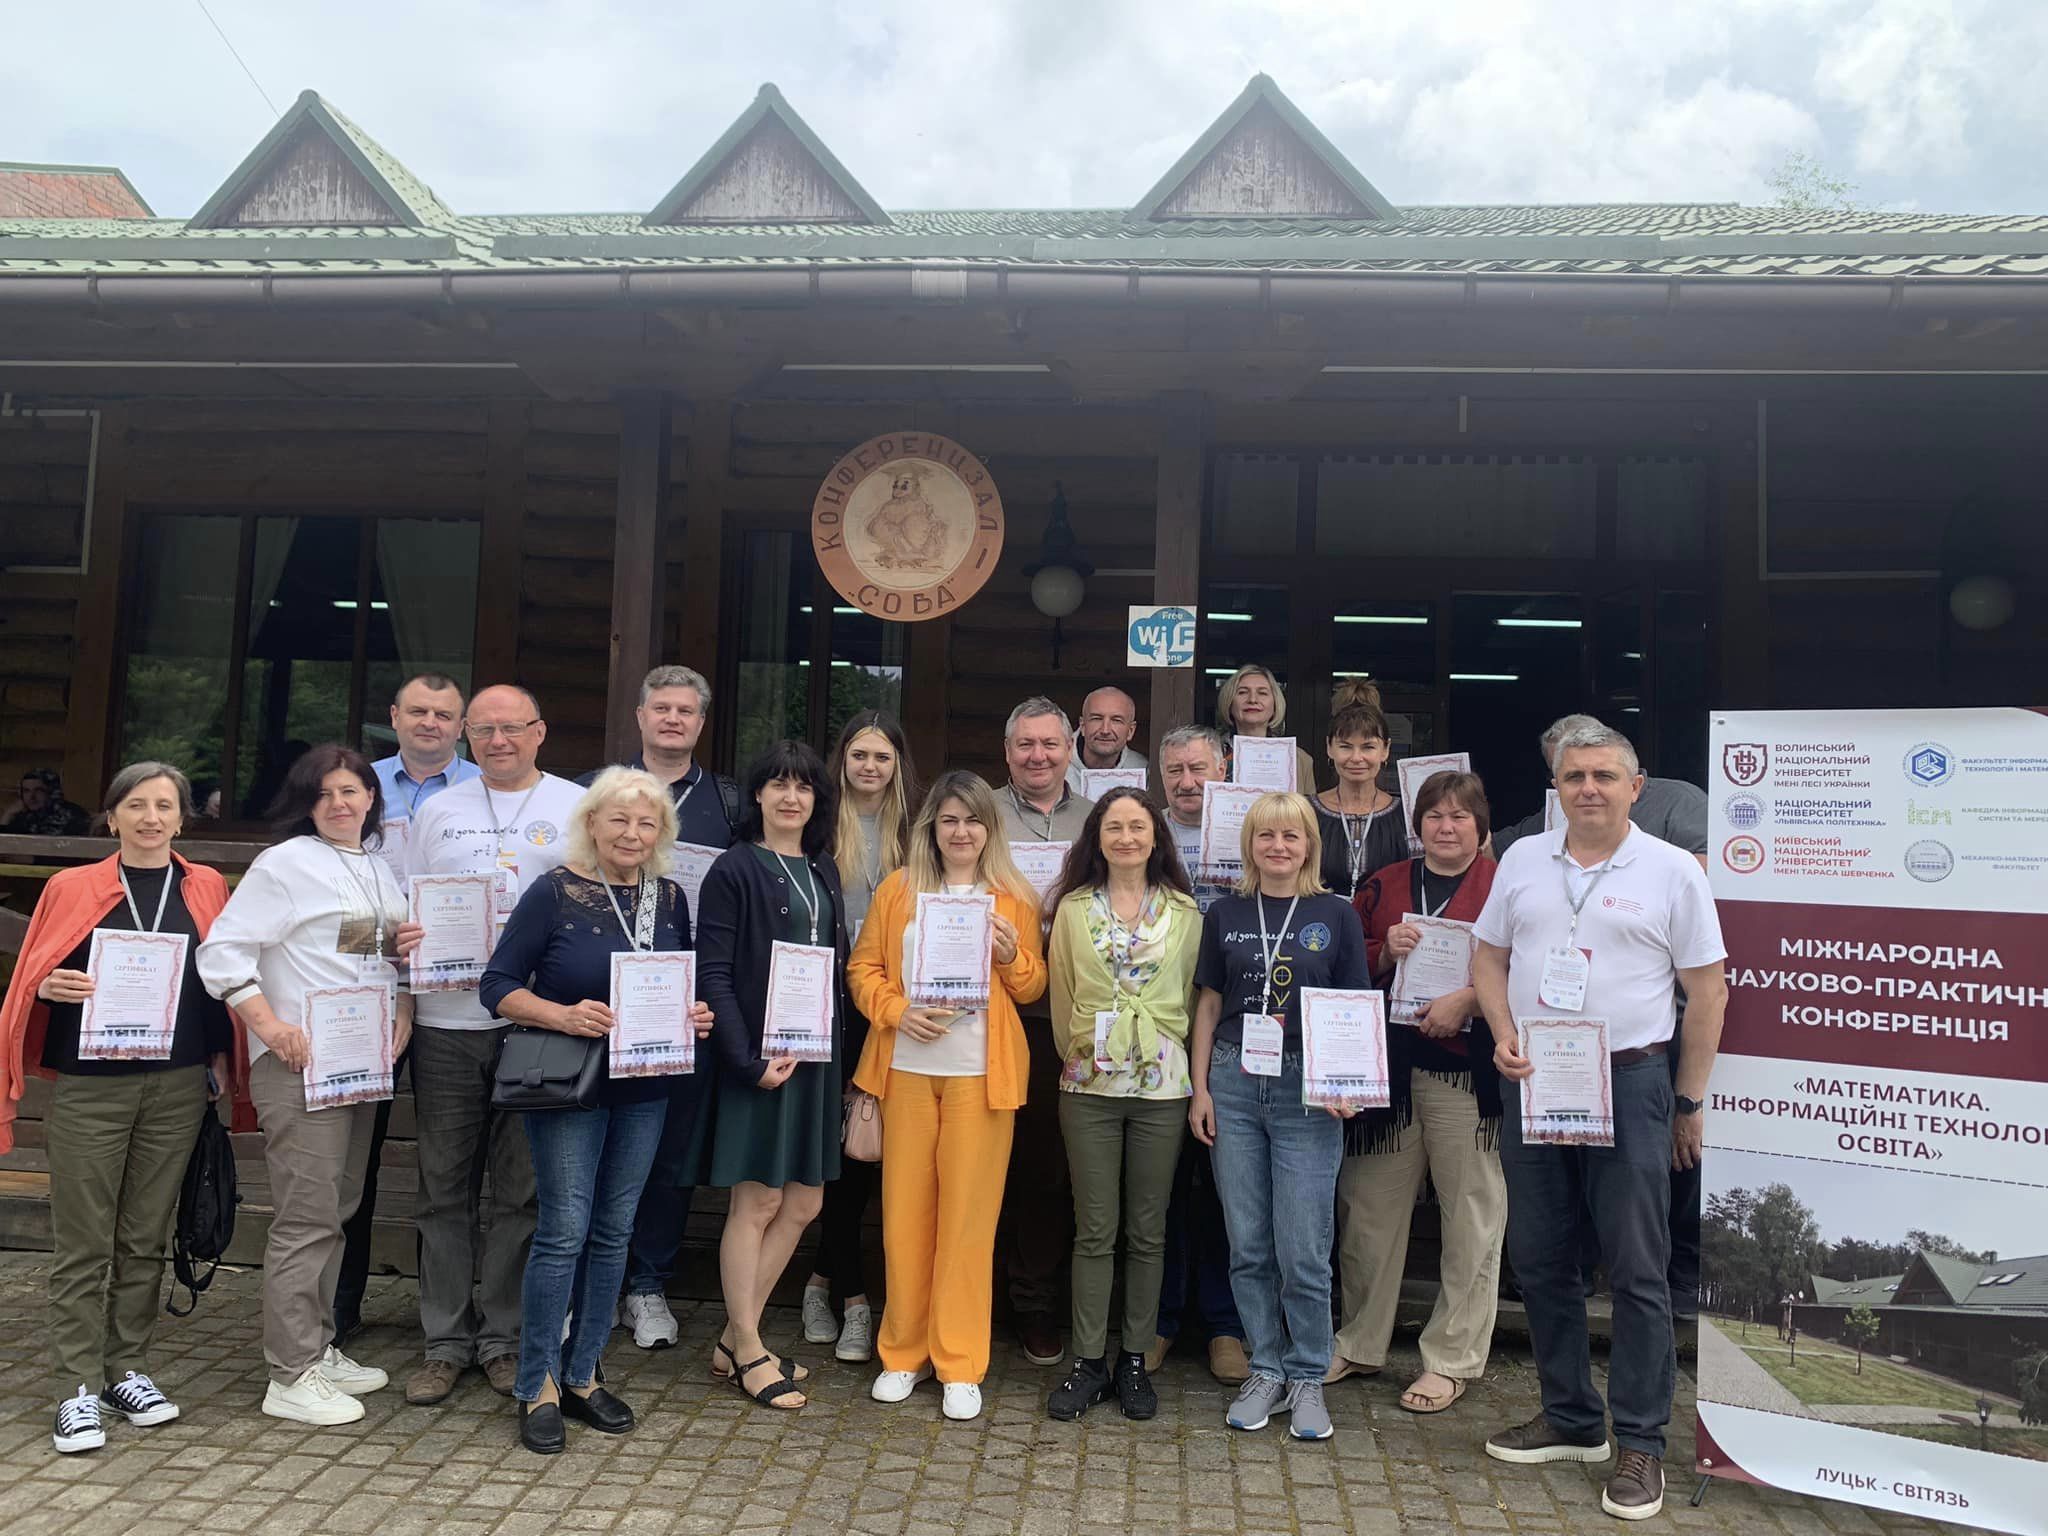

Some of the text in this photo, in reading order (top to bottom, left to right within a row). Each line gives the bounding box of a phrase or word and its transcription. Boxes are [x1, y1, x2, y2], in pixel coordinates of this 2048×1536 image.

[1775, 742, 1856, 752] ВОЛИНСЬКИЙ
[1775, 755, 1871, 766] НАЦІОНАЛЬНИЙ
[1774, 769, 1852, 777] УНІВЕРСИТЕТ
[1774, 779, 1871, 788] ІМЕНІ ЛЕСІ УКРАЇНКИ
[1774, 799, 1872, 809] НАЦІОНАЛЬНИЙ
[1774, 809, 1853, 818] УНІВЕРСИТЕТ
[441, 828, 454, 840] All
[1774, 836, 1842, 847] КИЇВСЬКИЙ
[1774, 847, 1871, 858] НАЦІОНАЛЬНИЙ
[1774, 857, 1853, 867] УНІВЕРСИТЕТ
[1774, 868, 1895, 878] ІМЕНІ ТАРАСА ШЕВЧЕНКА
[1225, 930, 1238, 942] All
[1780, 937, 2003, 970] МІЖНАРОДНА
[1782, 1004, 2009, 1042] КОНФЕРЕНЦІЯ
[1793, 1077, 1991, 1113] «МАТЕМАТИКА.
[1711, 1094, 1907, 1130] ІНФОРМАЦІЙНІ
[1838, 1133, 1943, 1160] ОСВІТА»
[1816, 1467, 1877, 1492] ЛУЦЬК
[1893, 1482, 1970, 1508] СВІТЯЗЬ
